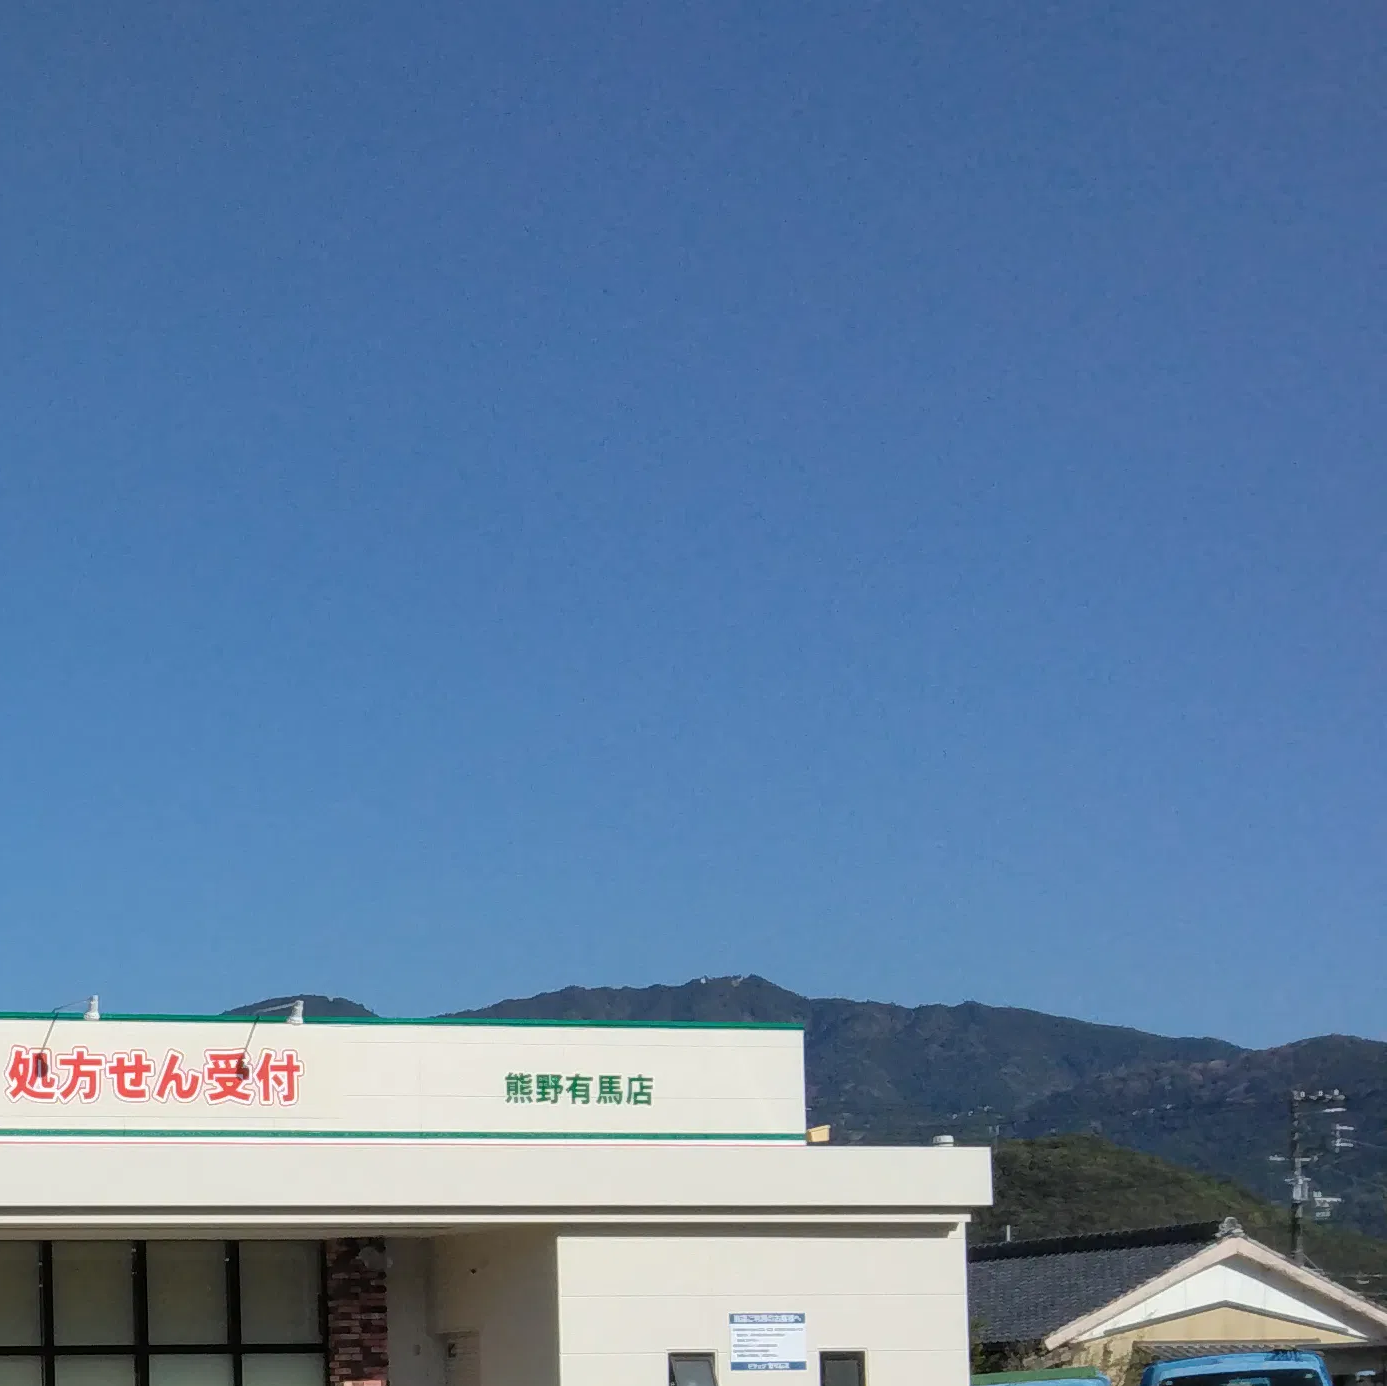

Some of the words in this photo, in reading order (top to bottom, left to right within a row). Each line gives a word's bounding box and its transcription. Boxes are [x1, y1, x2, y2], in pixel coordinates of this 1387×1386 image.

[7, 1048, 301, 1103] 処方せん受付
[505, 1073, 653, 1106] 熊野有馬店
